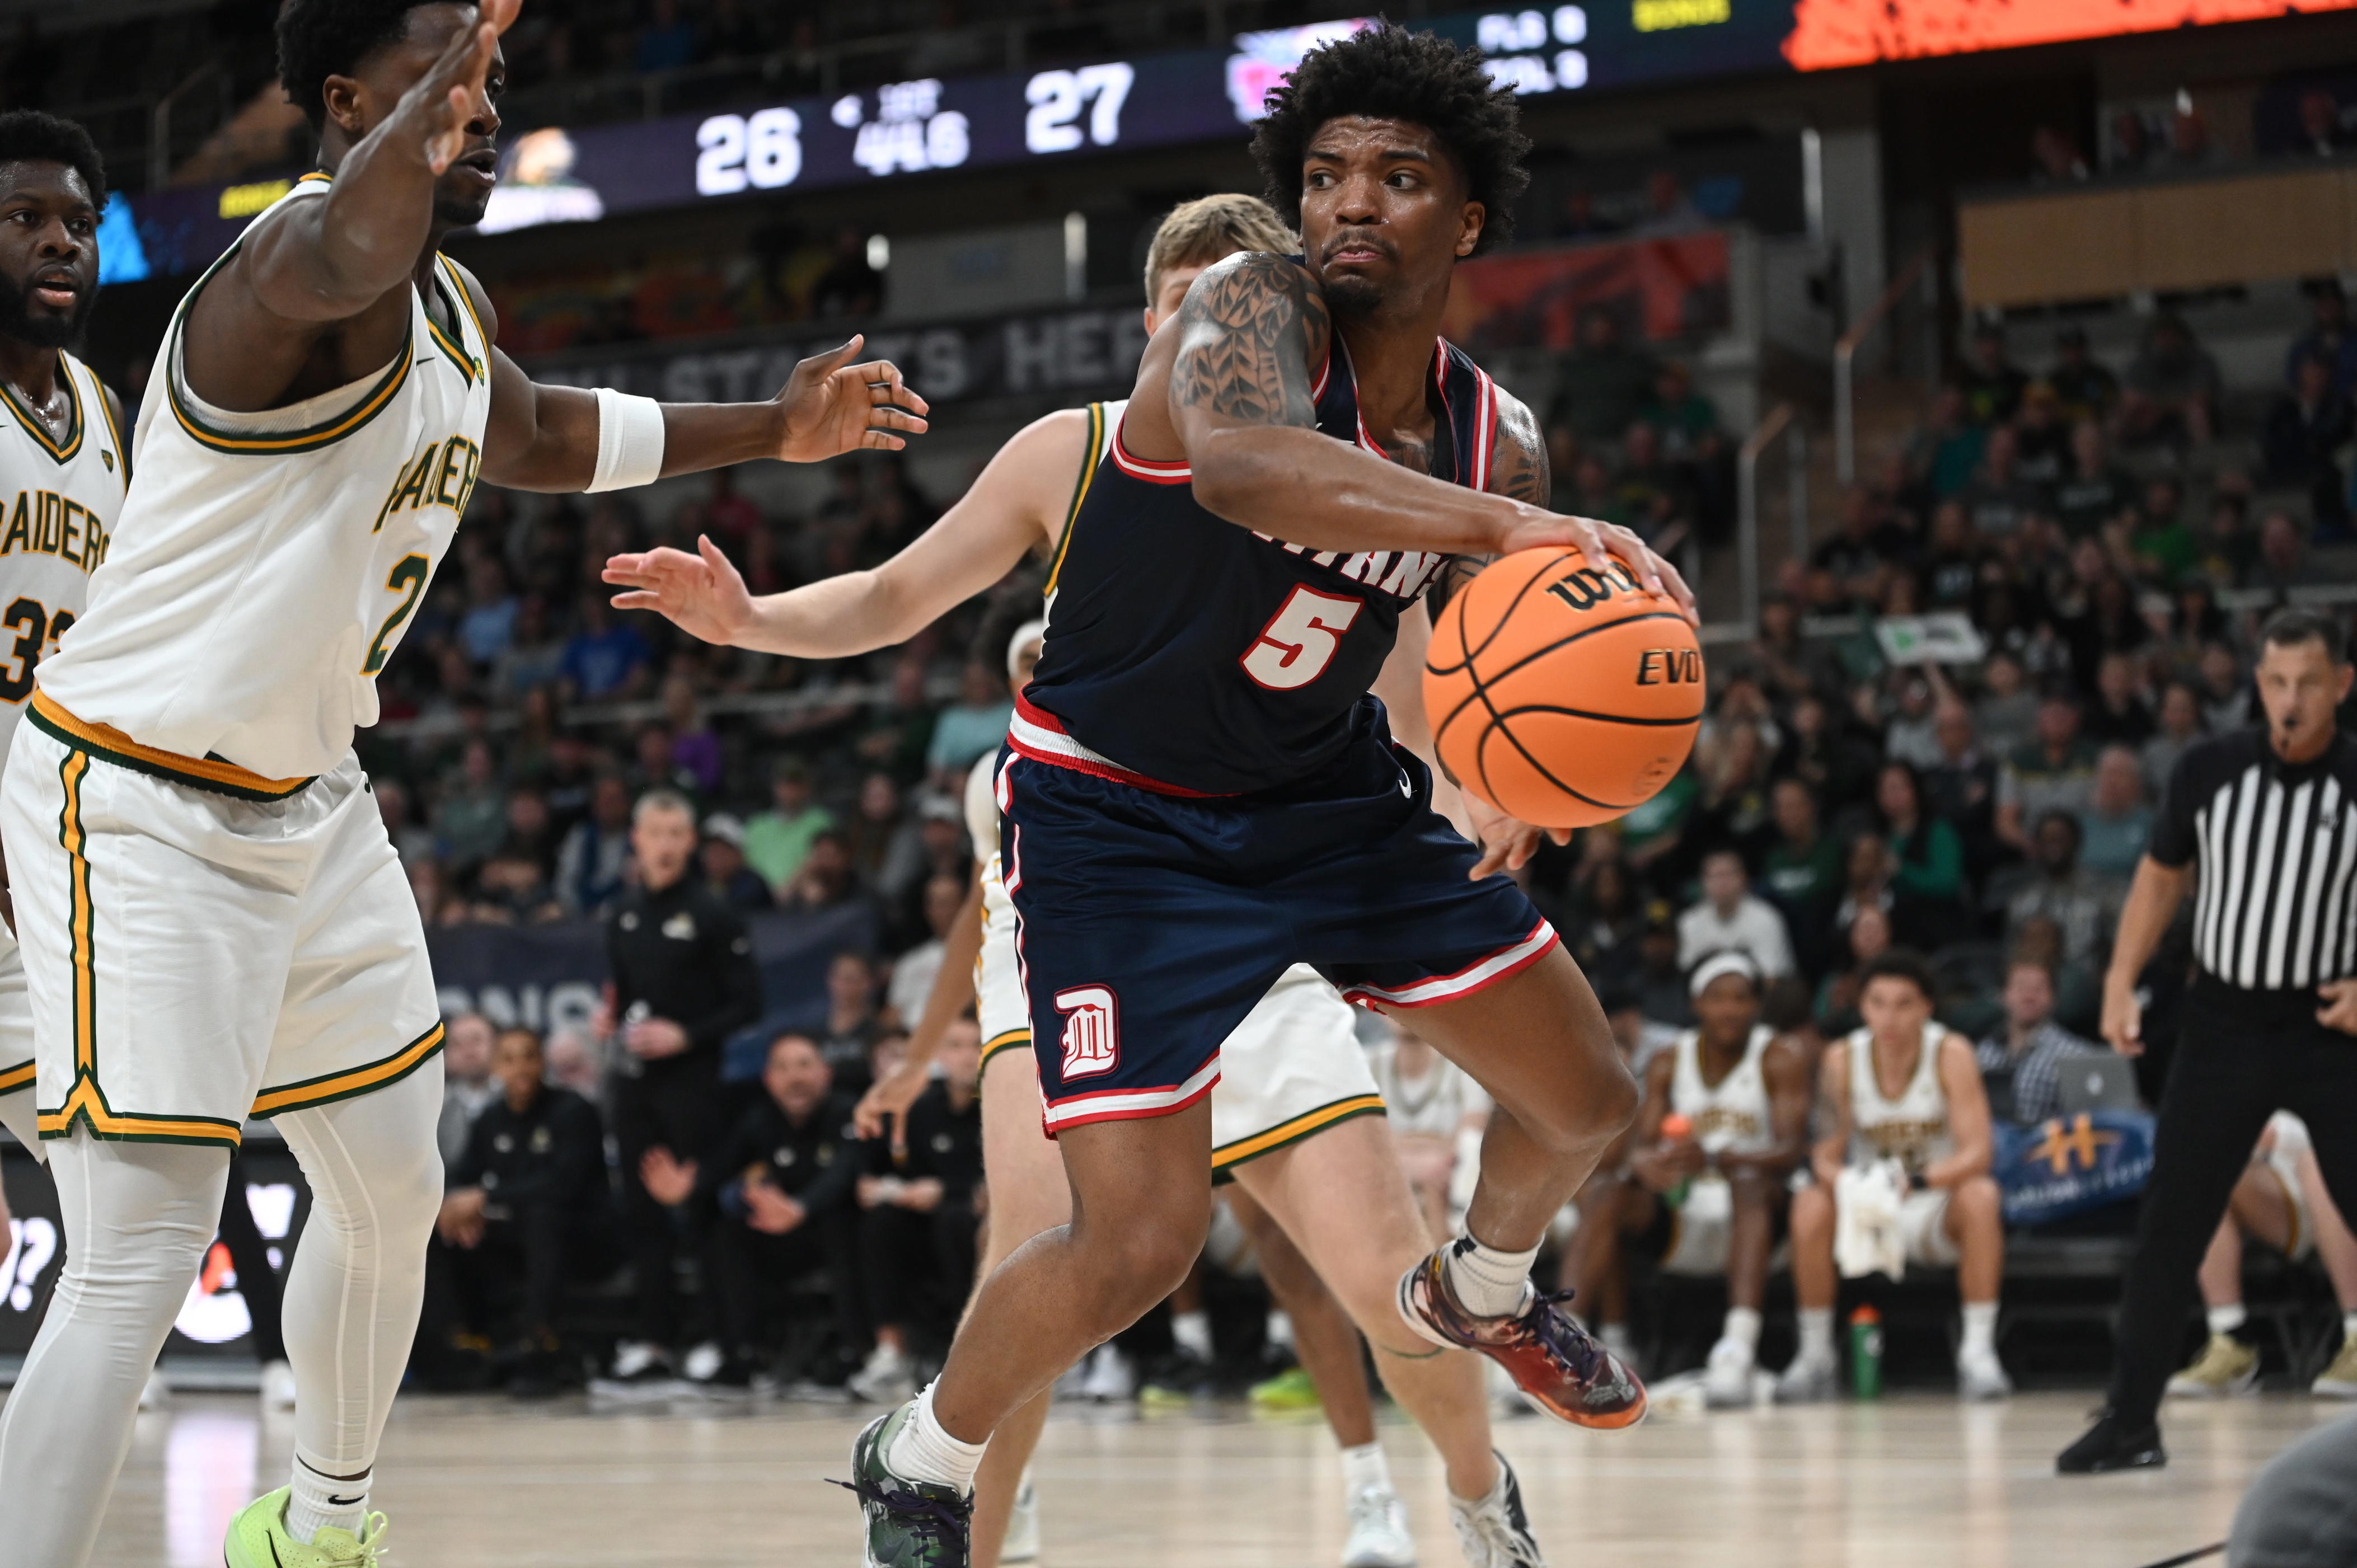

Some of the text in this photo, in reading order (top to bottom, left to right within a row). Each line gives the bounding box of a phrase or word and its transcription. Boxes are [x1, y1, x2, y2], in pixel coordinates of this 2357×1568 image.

[696, 107, 802, 196] 26
[1025, 62, 1135, 154] 27
[0, 490, 111, 576] AIDER
[359, 551, 429, 676] 2
[1238, 581, 1365, 691] 5
[1636, 648, 1700, 686] EVO
